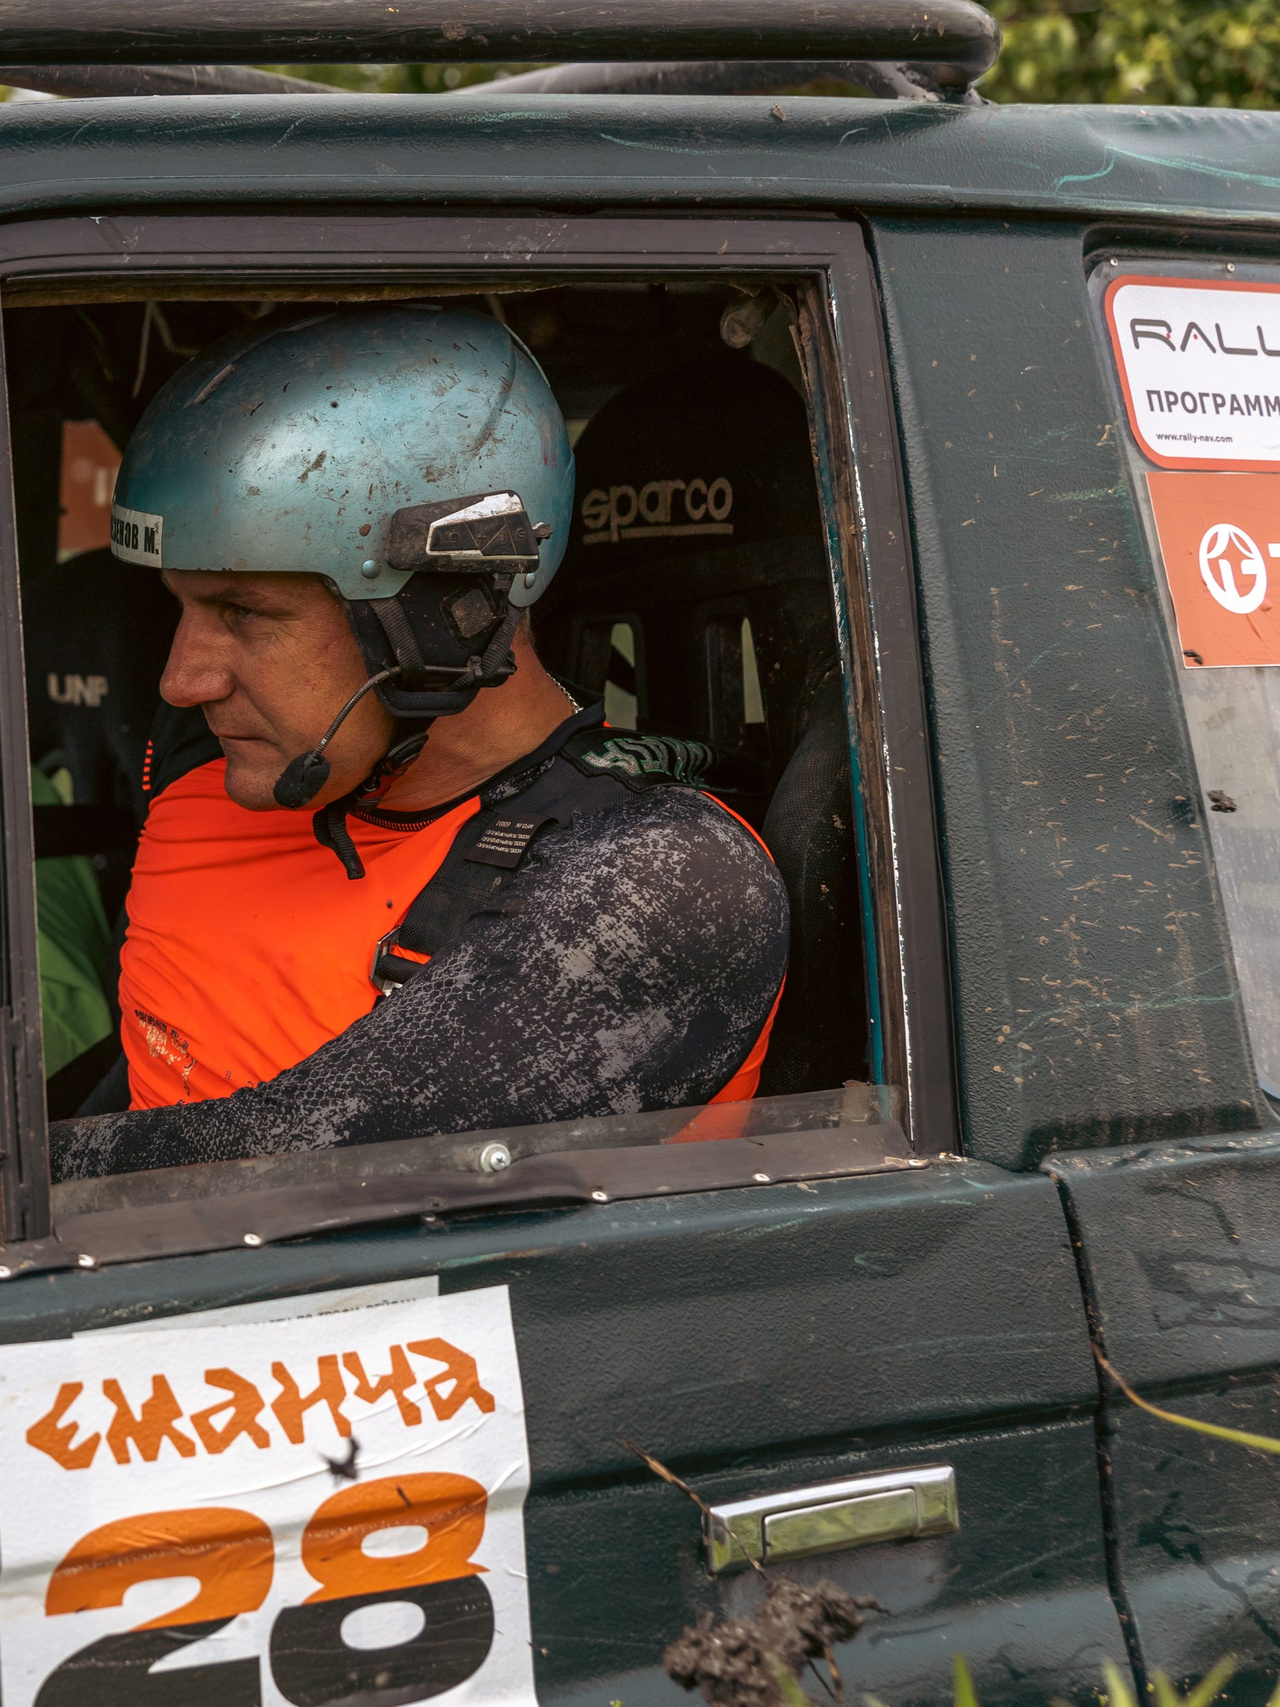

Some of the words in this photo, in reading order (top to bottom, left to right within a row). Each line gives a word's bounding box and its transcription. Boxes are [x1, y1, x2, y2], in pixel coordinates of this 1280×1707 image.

[1156, 432, 1233, 444] www.rally-nav.com
[582, 477, 733, 543] sparco
[32, 1471, 496, 1707] 28
